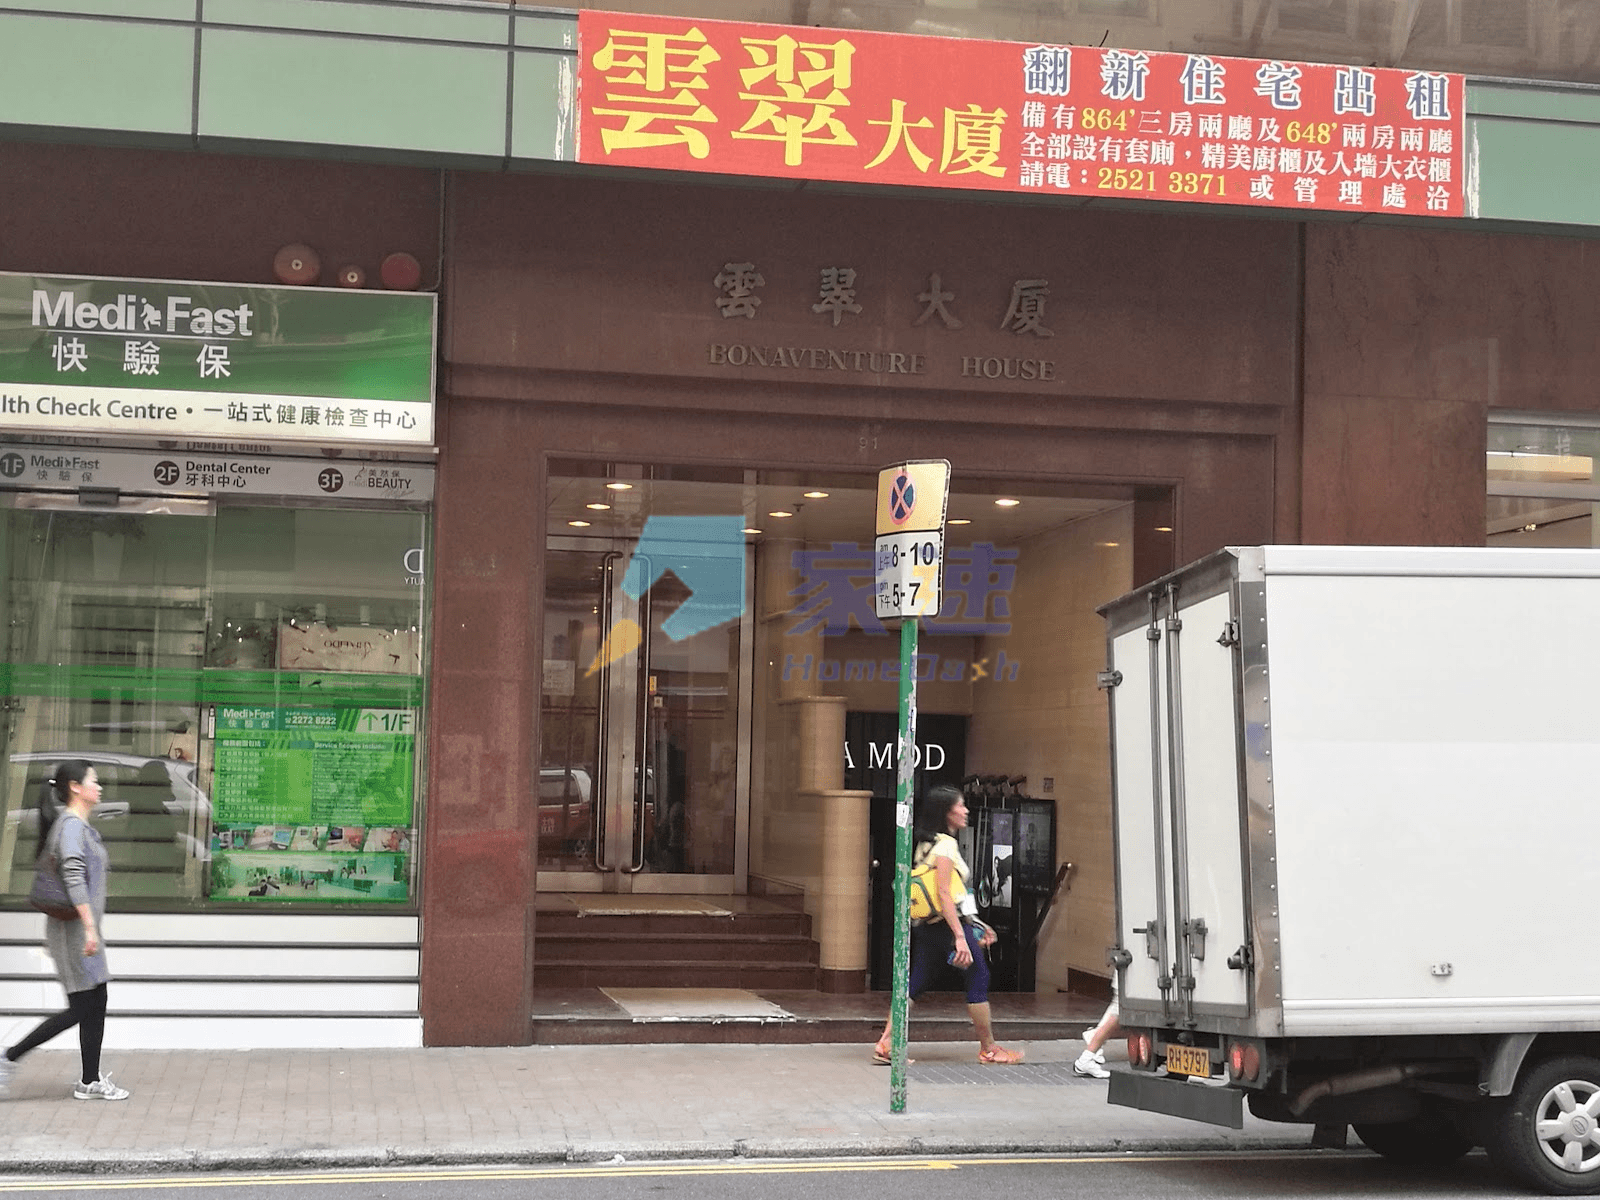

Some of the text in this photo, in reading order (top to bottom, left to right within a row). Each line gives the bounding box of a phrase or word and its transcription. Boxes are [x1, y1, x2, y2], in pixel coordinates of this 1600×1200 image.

[1023, 45, 1450, 120] 翻新住宅出租
[592, 26, 1008, 178] 雲翠大廈
[1168, 171, 1226, 196] 3371
[1249, 174, 1450, 211] 或管理處洽
[32, 289, 253, 336] Medi Fast
[51, 336, 231, 379] 快驗保
[709, 344, 1055, 381] BONAVENTURE HOUSE
[36, 396, 101, 417] Check
[106, 399, 178, 420] Centre
[203, 401, 417, 430] 一站式健康檢查中心
[2, 454, 99, 474] 1F Medi Fast
[156, 460, 270, 482] 2F Dental Center
[185, 473, 246, 488] 牙科中心
[320, 473, 342, 489] 3F
[878, 555, 890, 571] 上午
[878, 594, 890, 609] 下午
[381, 711, 412, 731] 1/F
[1169, 1048, 1208, 1073] RH 3797
